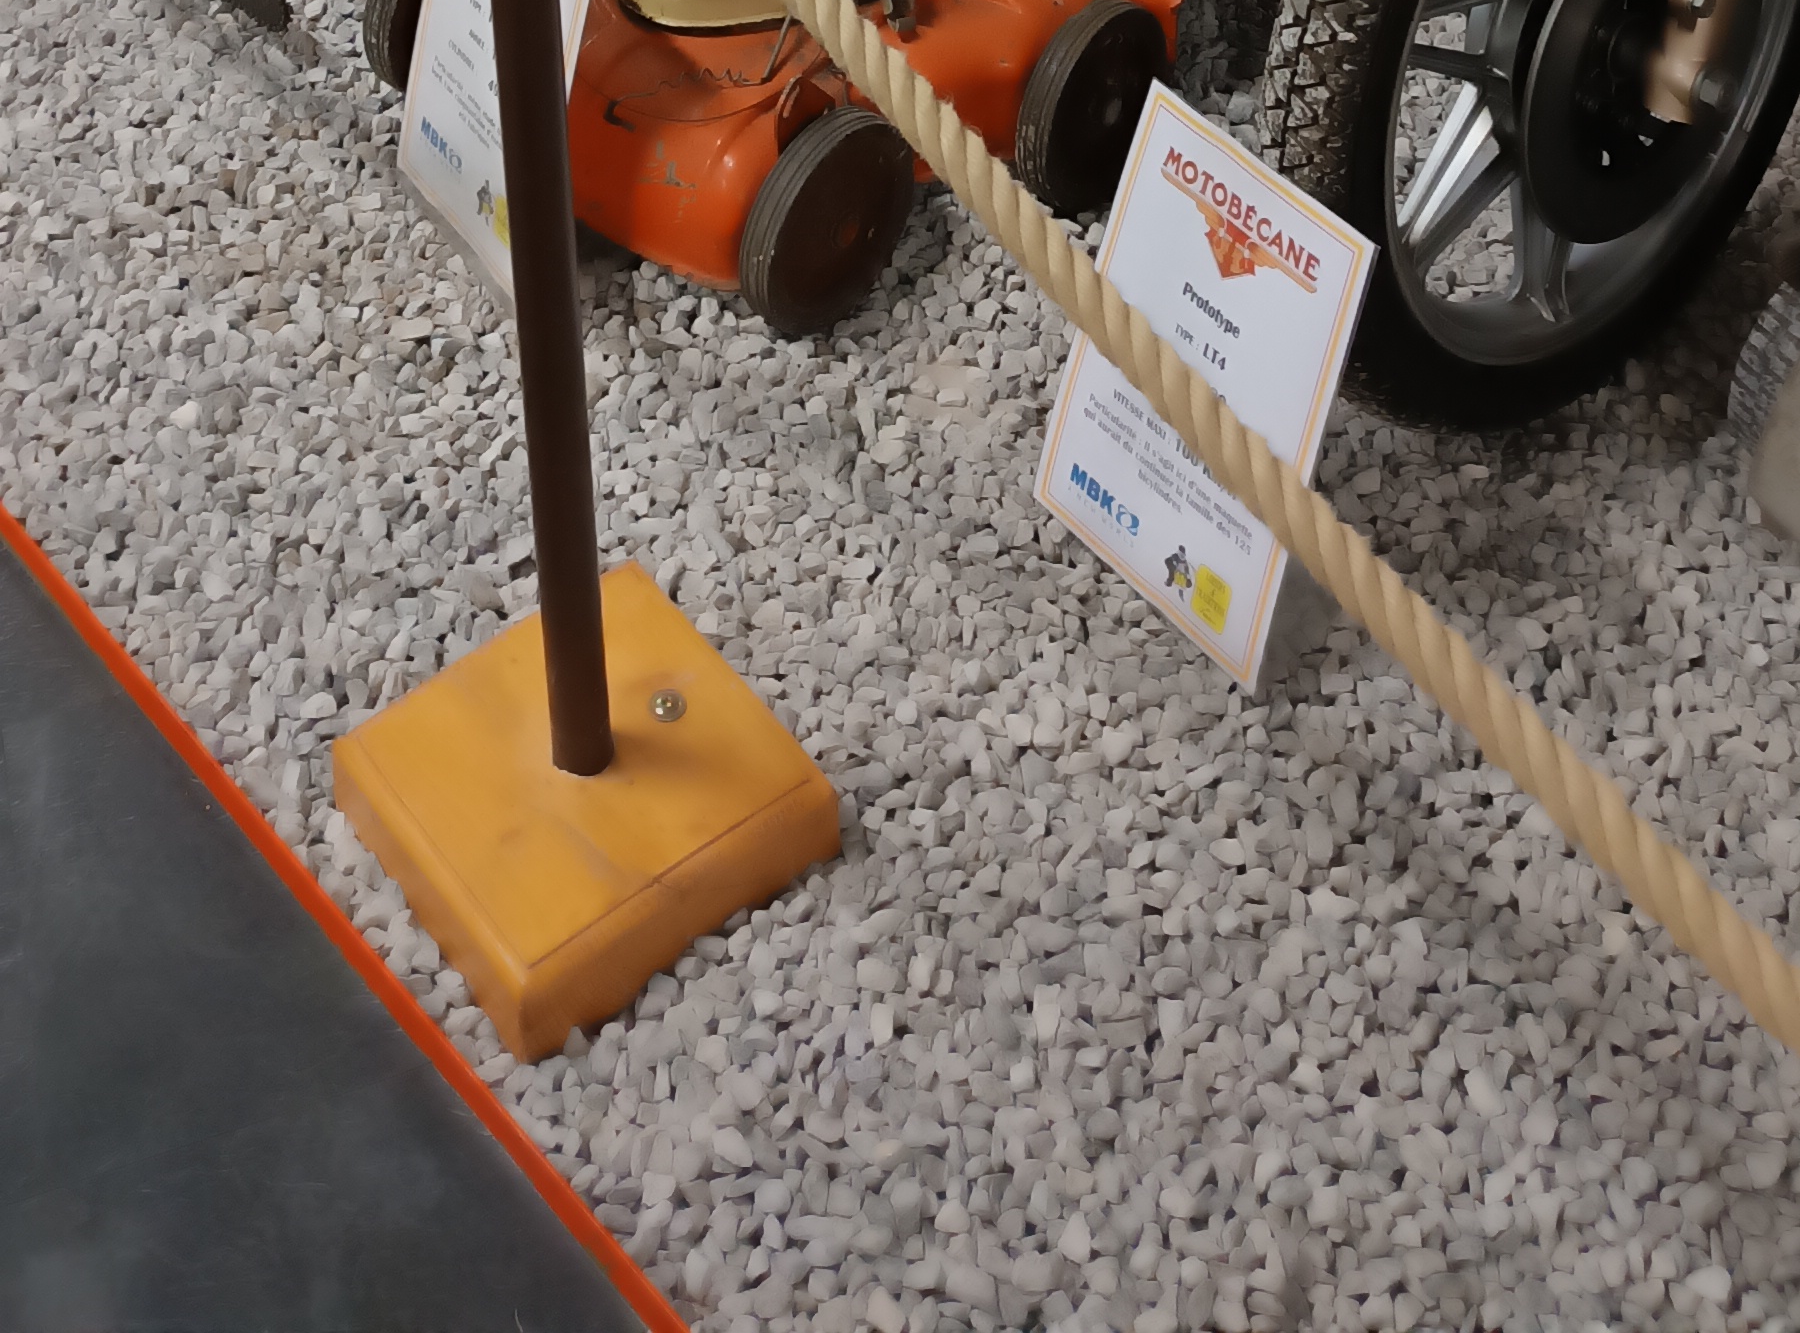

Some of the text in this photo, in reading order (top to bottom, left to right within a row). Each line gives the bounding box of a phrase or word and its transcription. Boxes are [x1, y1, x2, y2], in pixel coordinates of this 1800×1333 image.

[421, 116, 448, 159] MBK
[1162, 146, 1321, 282] MOTOBÉCANE
[1182, 281, 1240, 339] Prototype
[1203, 342, 1226, 371] LT4
[1113, 388, 1145, 421] VITESSE
[1146, 416, 1167, 440] MAXI
[1070, 463, 1116, 517] MBK
[1083, 407, 1096, 422] qui
[1097, 419, 1122, 445] aurait
[1135, 451, 1174, 488] continuer
[1176, 484, 1184, 498] la
[1216, 521, 1231, 539] des
[1234, 535, 1252, 556] 125
[1213, 501, 1253, 540] maquette
